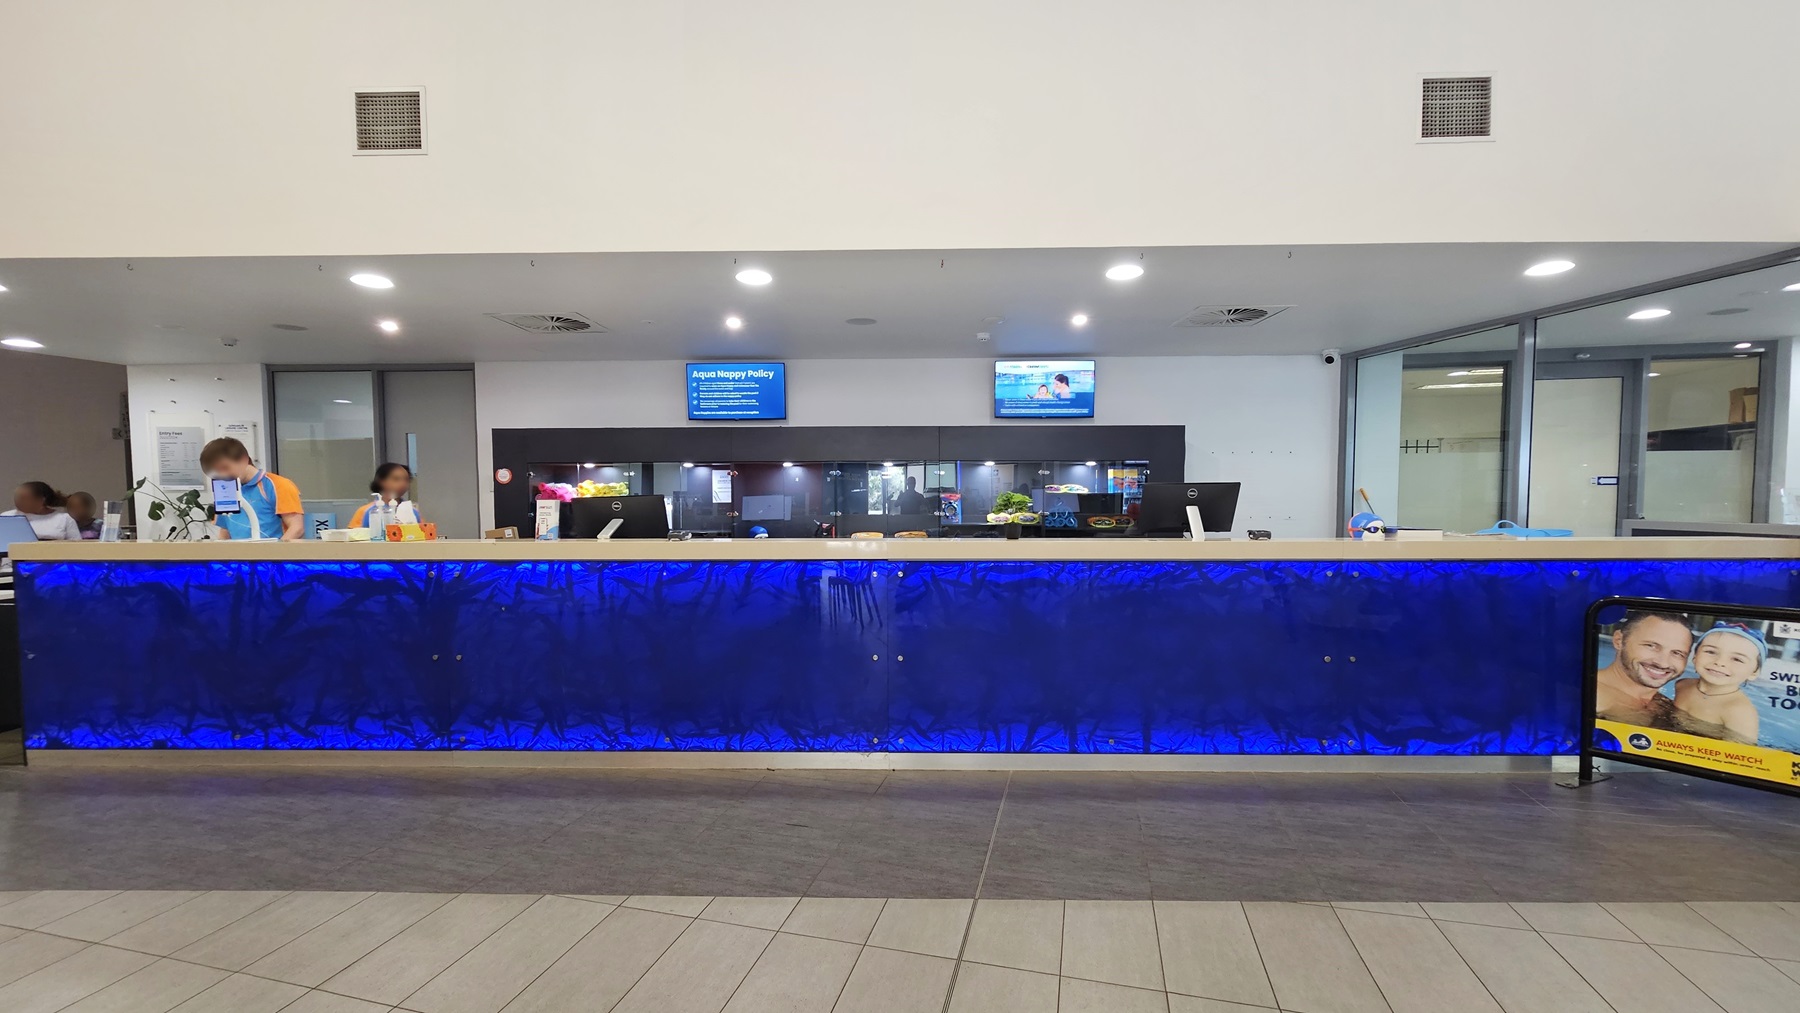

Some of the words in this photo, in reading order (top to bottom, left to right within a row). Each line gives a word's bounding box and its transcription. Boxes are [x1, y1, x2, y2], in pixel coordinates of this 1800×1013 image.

[692, 370, 716, 380] Aqua
[717, 370, 746, 380] Nappy
[747, 369, 774, 380] Policy
[1786, 685, 1800, 697] B
[1768, 696, 1800, 710] TO
[1656, 740, 1694, 752] ALWAYS
[1697, 747, 1721, 757] KEEP
[1724, 752, 1763, 765] WATCH
